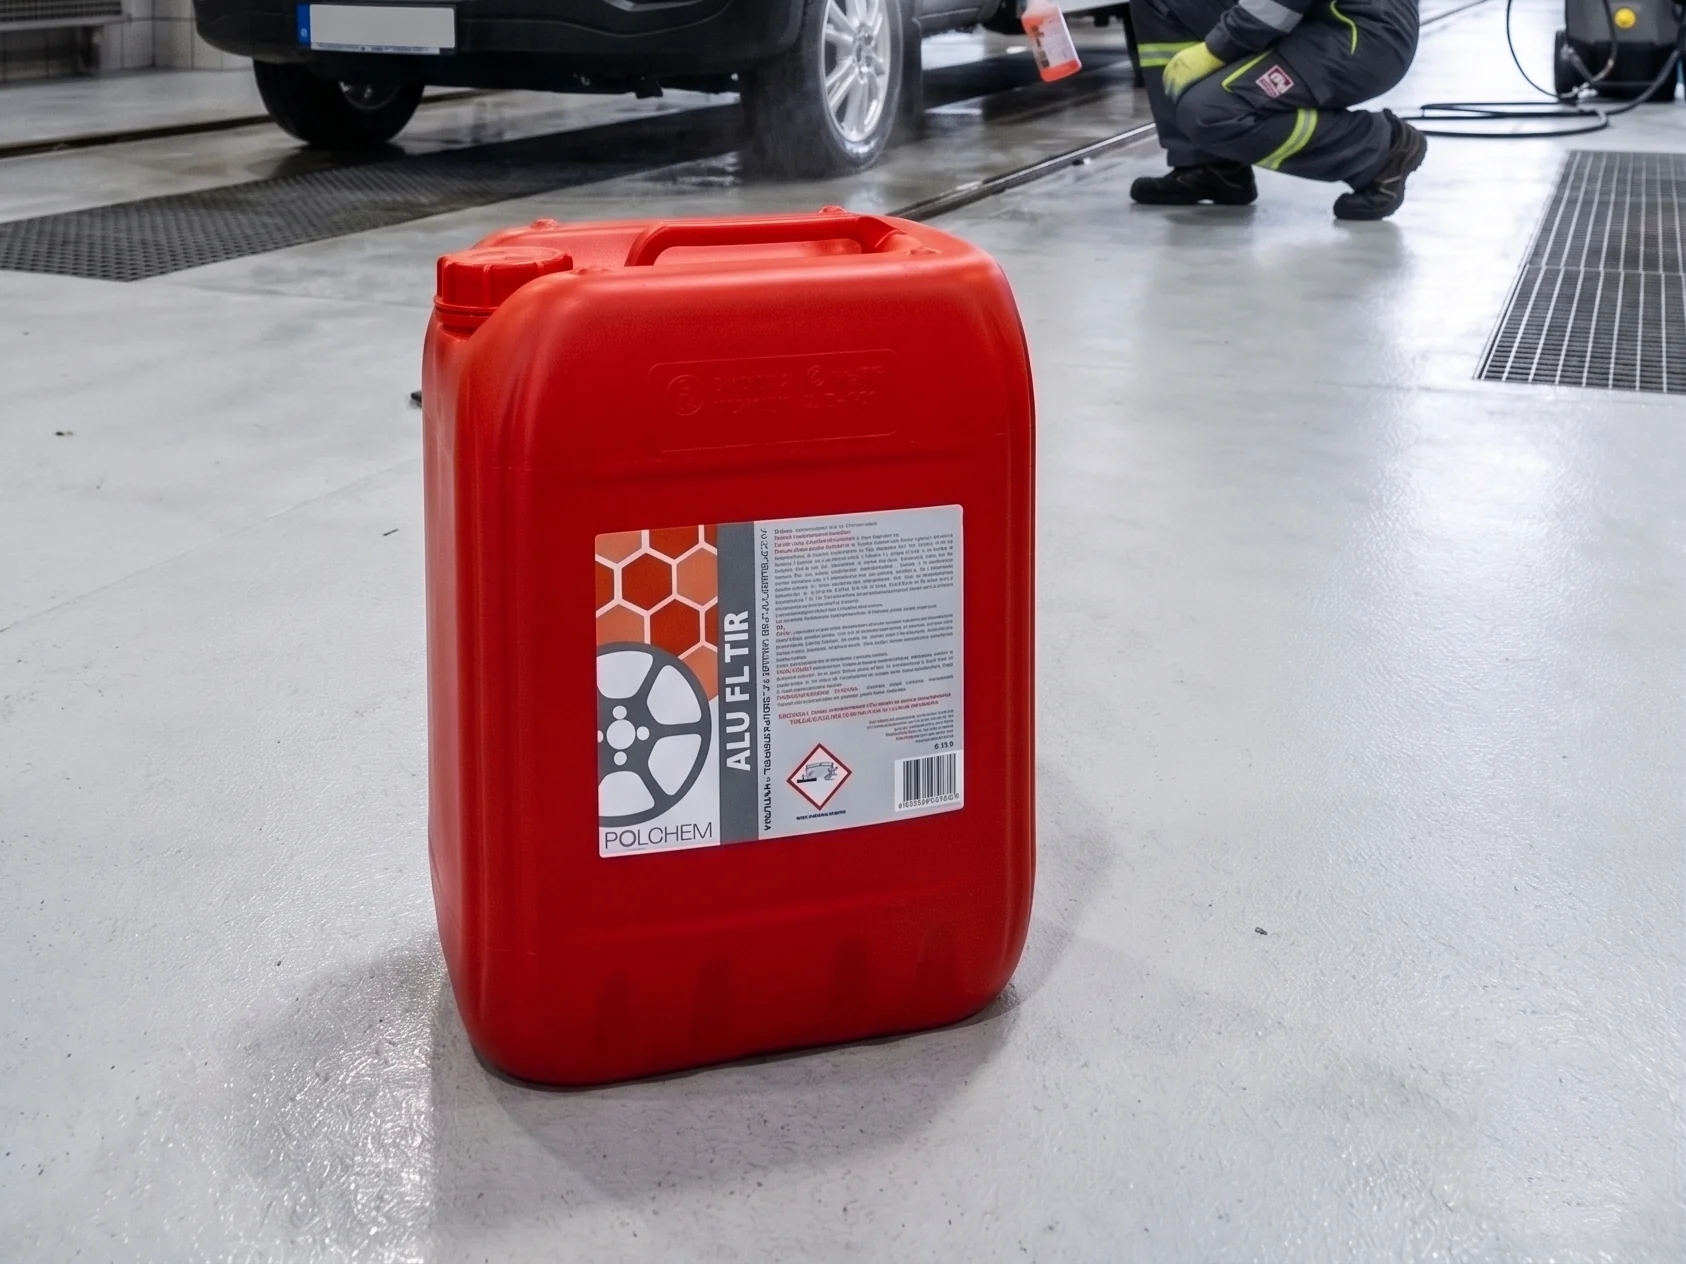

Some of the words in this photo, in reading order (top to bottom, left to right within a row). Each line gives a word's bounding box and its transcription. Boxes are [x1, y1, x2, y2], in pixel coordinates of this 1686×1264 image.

[723, 610, 749, 663] TIR
[725, 665, 750, 703] FL
[725, 711, 751, 771] ALU
[604, 822, 713, 849] POLCHEM
